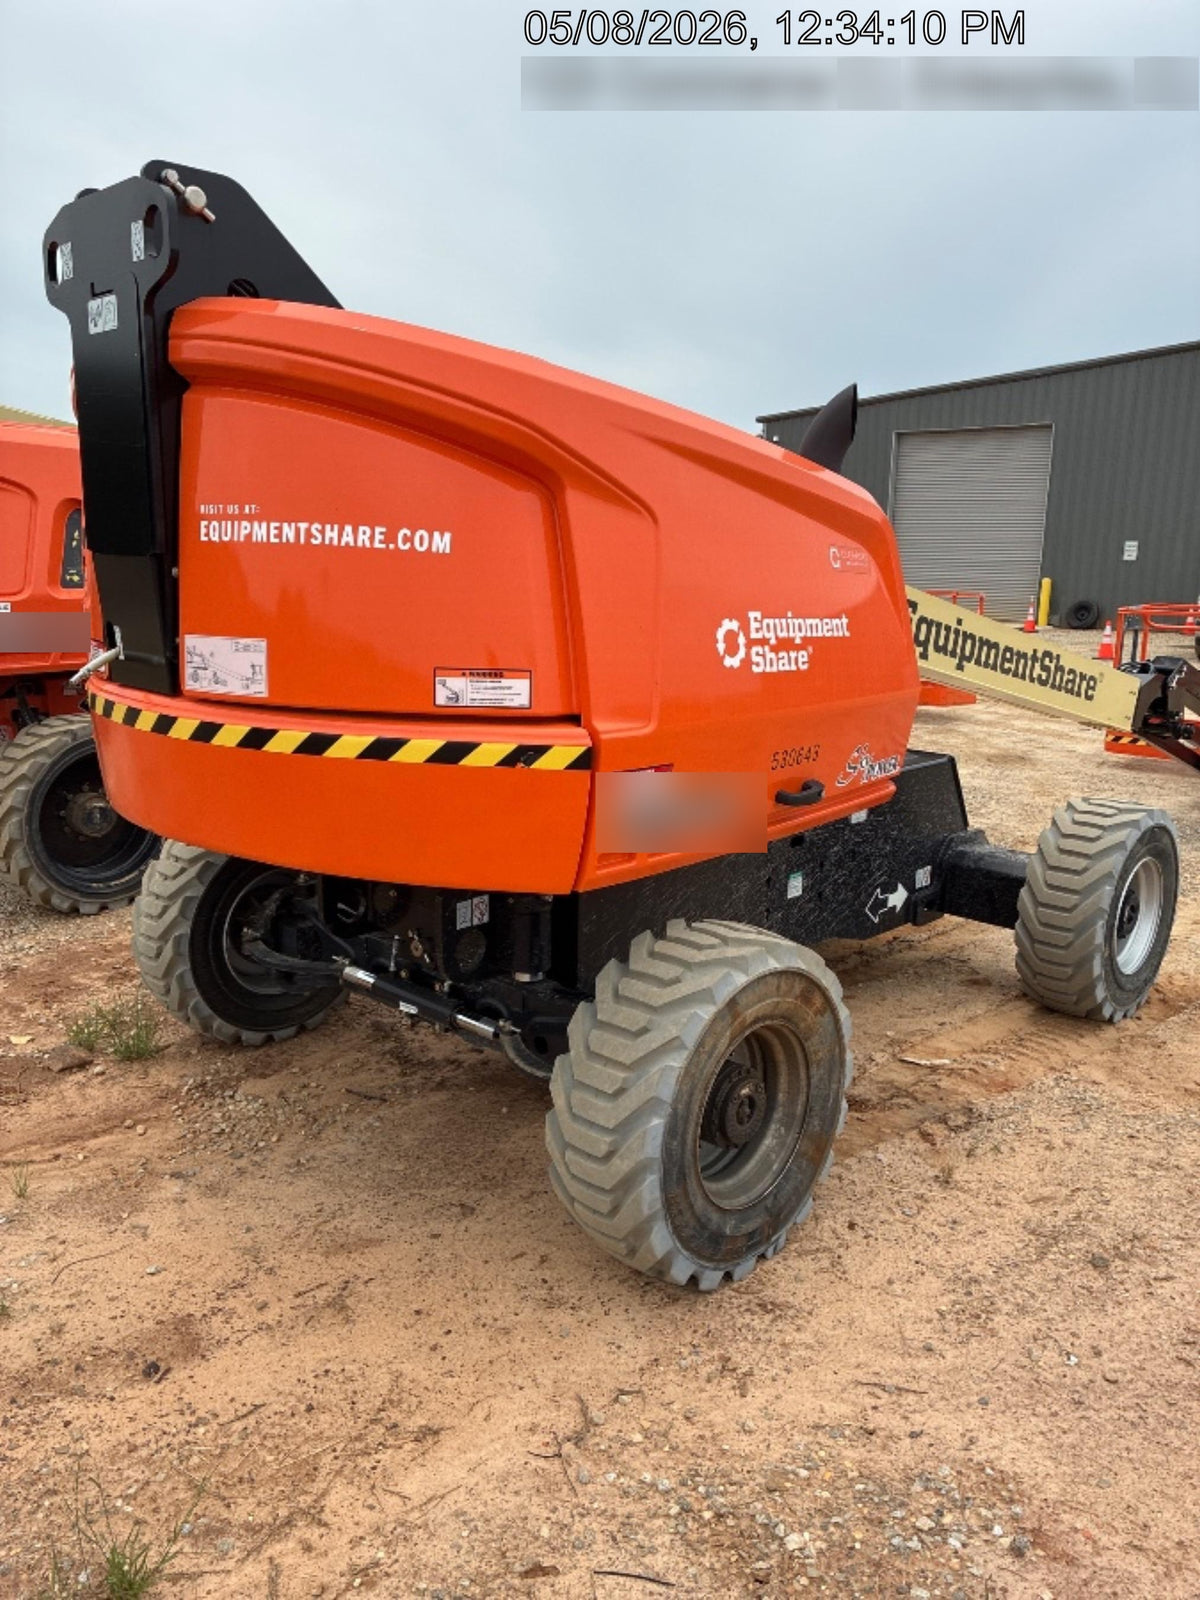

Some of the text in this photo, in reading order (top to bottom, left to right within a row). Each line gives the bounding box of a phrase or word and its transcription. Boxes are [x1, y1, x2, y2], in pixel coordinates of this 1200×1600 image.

[227, 504, 239, 514] US
[200, 520, 452, 554] EQUIPMENTSHARE.COM
[748, 610, 851, 645] Equipment
